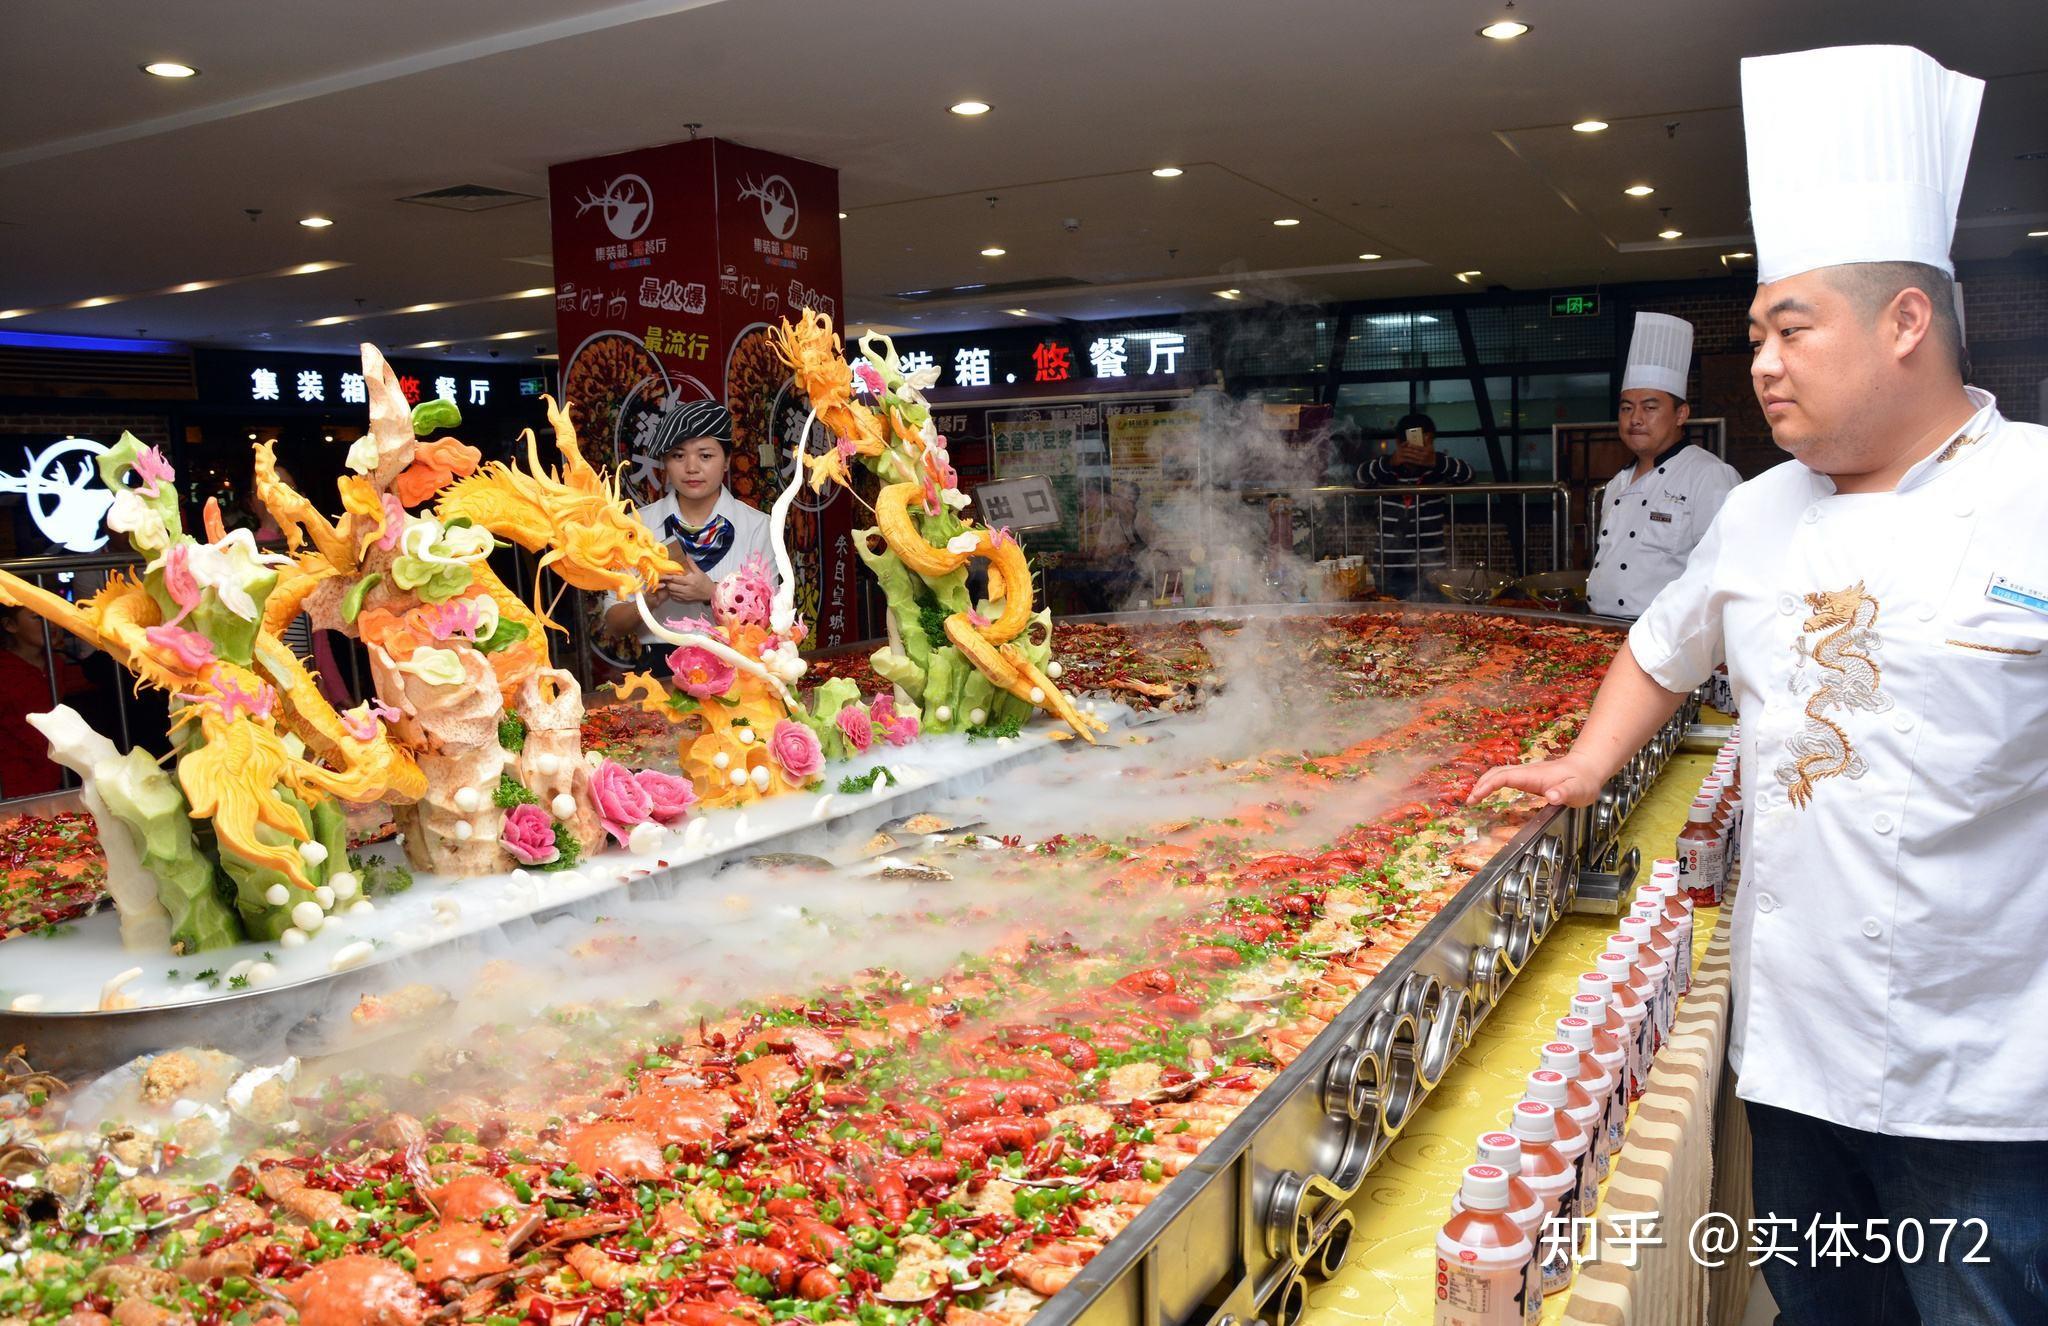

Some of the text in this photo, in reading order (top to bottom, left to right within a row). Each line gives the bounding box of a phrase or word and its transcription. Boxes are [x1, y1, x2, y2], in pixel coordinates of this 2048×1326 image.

[557, 283, 628, 320] 最时尚
[639, 277, 706, 315] 最火爆
[643, 326, 710, 361] 最流行
[986, 489, 1051, 522] 出口
